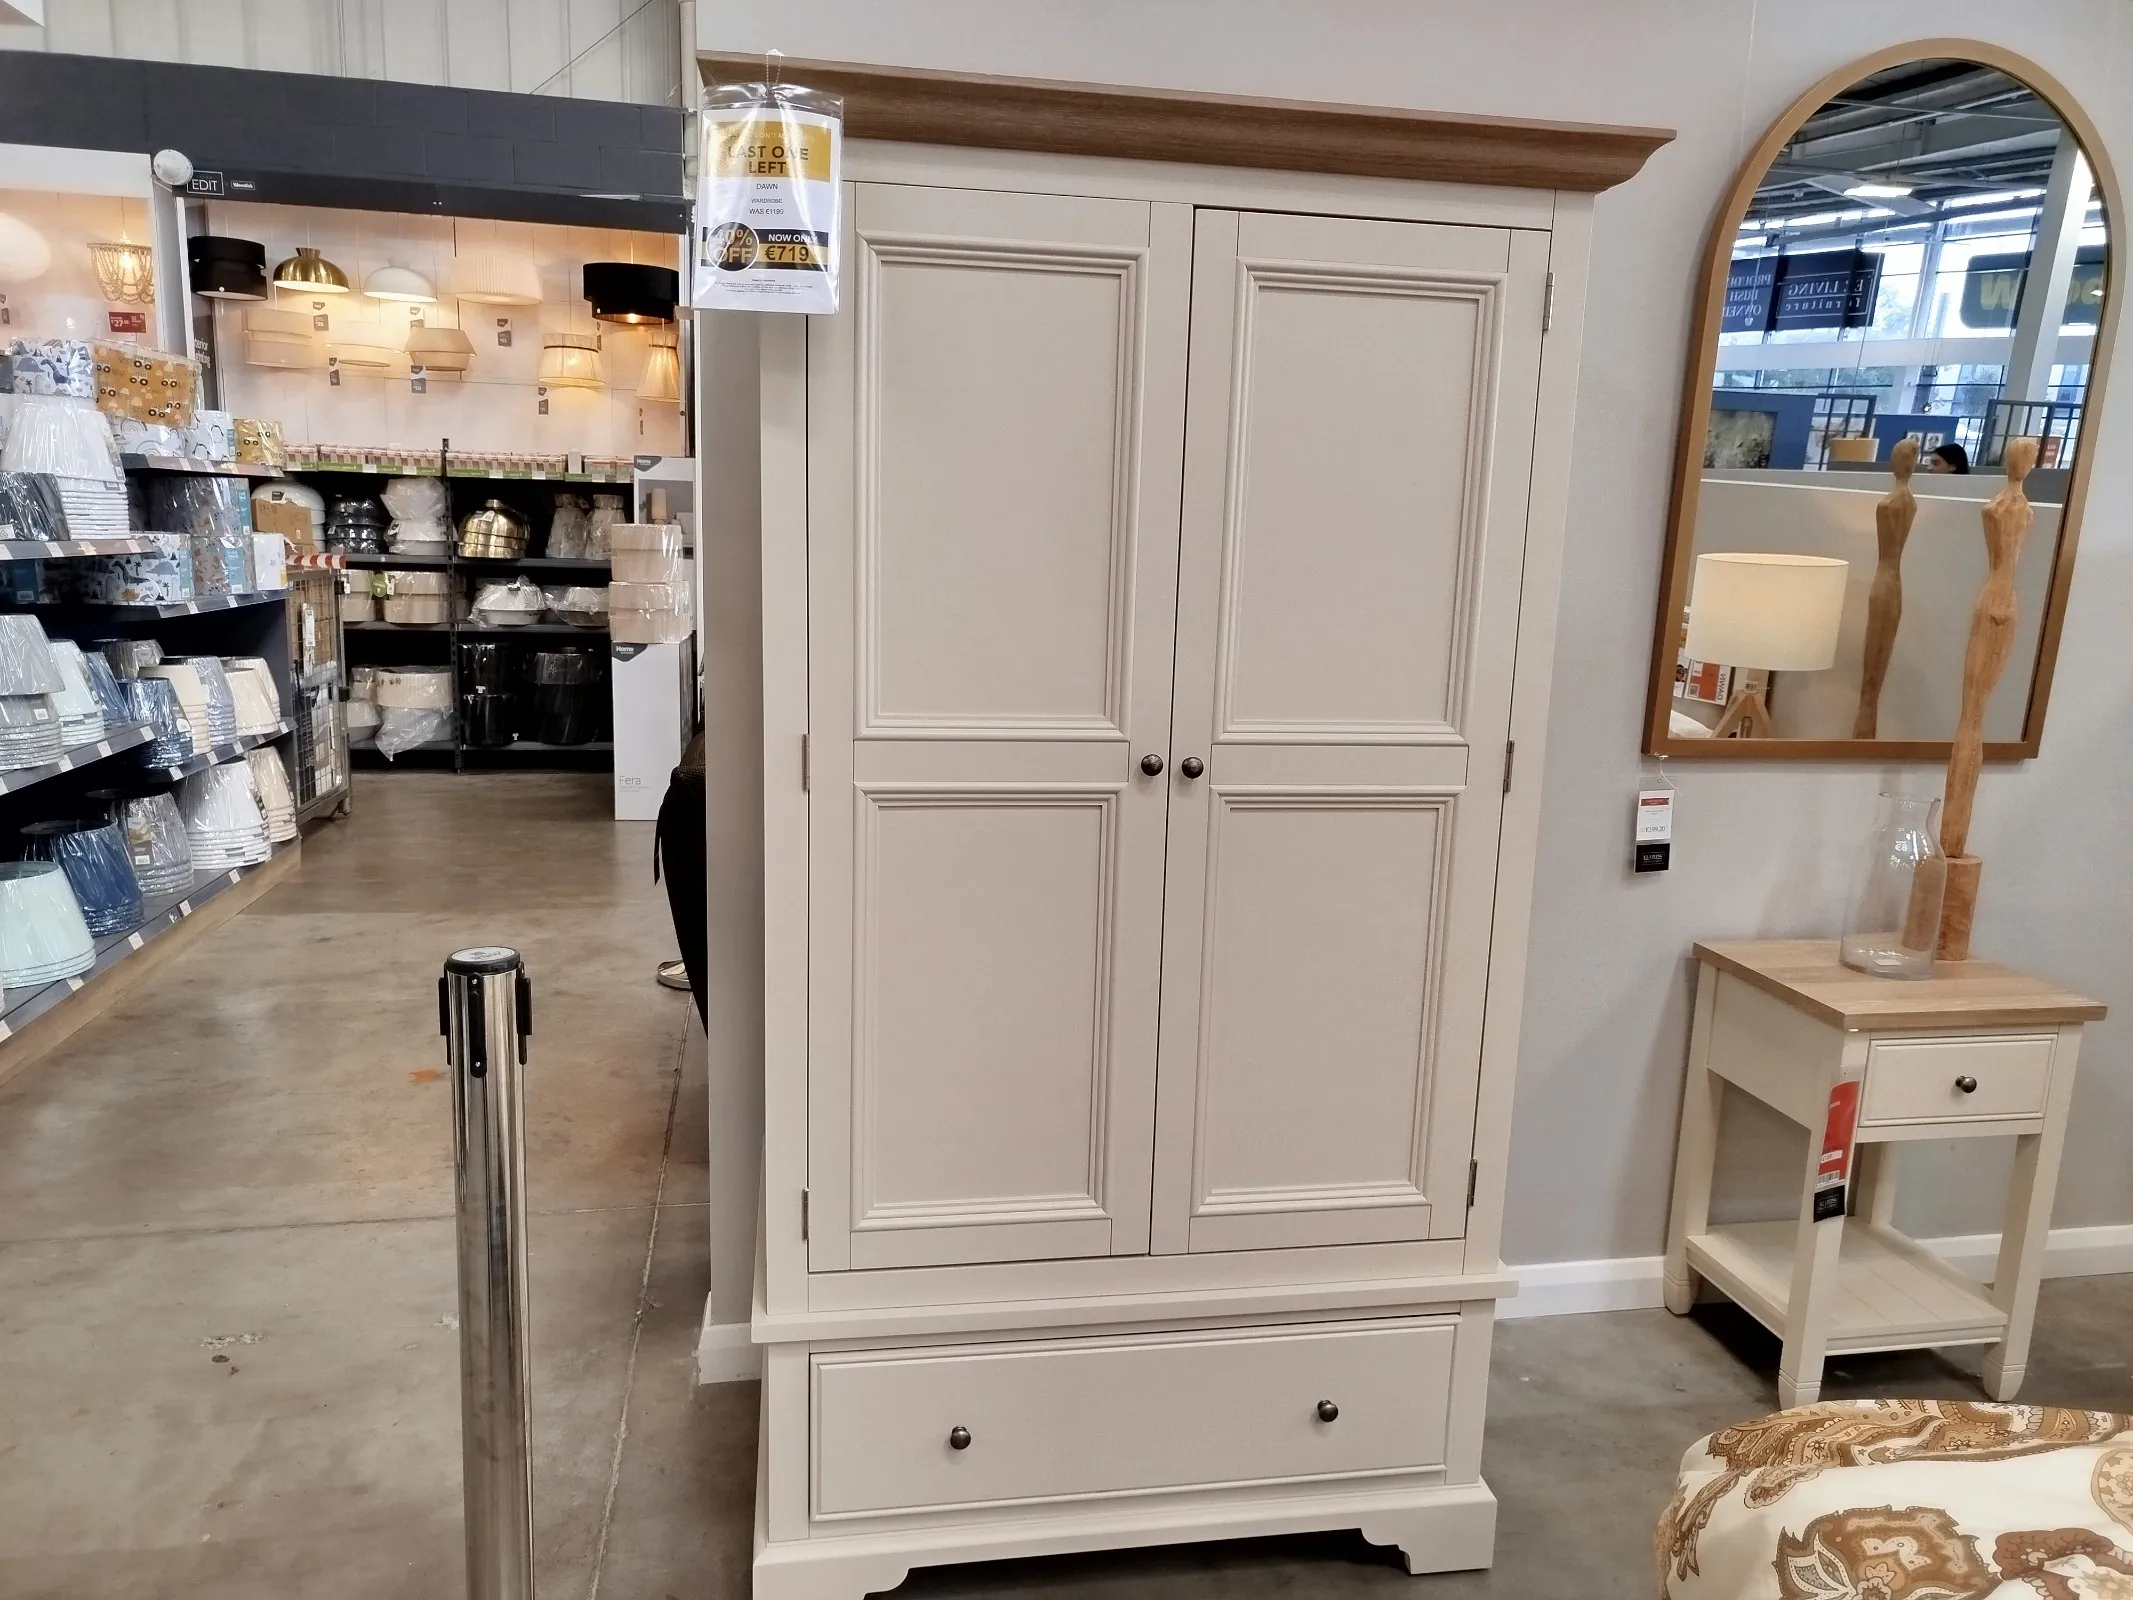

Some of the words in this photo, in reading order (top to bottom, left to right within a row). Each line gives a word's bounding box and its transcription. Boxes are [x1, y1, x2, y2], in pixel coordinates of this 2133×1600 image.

[728, 145, 766, 159] LAST
[748, 161, 786, 174] LEFT
[192, 179, 218, 192] EDIT
[768, 233, 791, 243] NOW
[793, 234, 818, 244] ONLY
[764, 245, 809, 262] €719
[616, 645, 635, 653] Home
[619, 775, 642, 785] Fera
